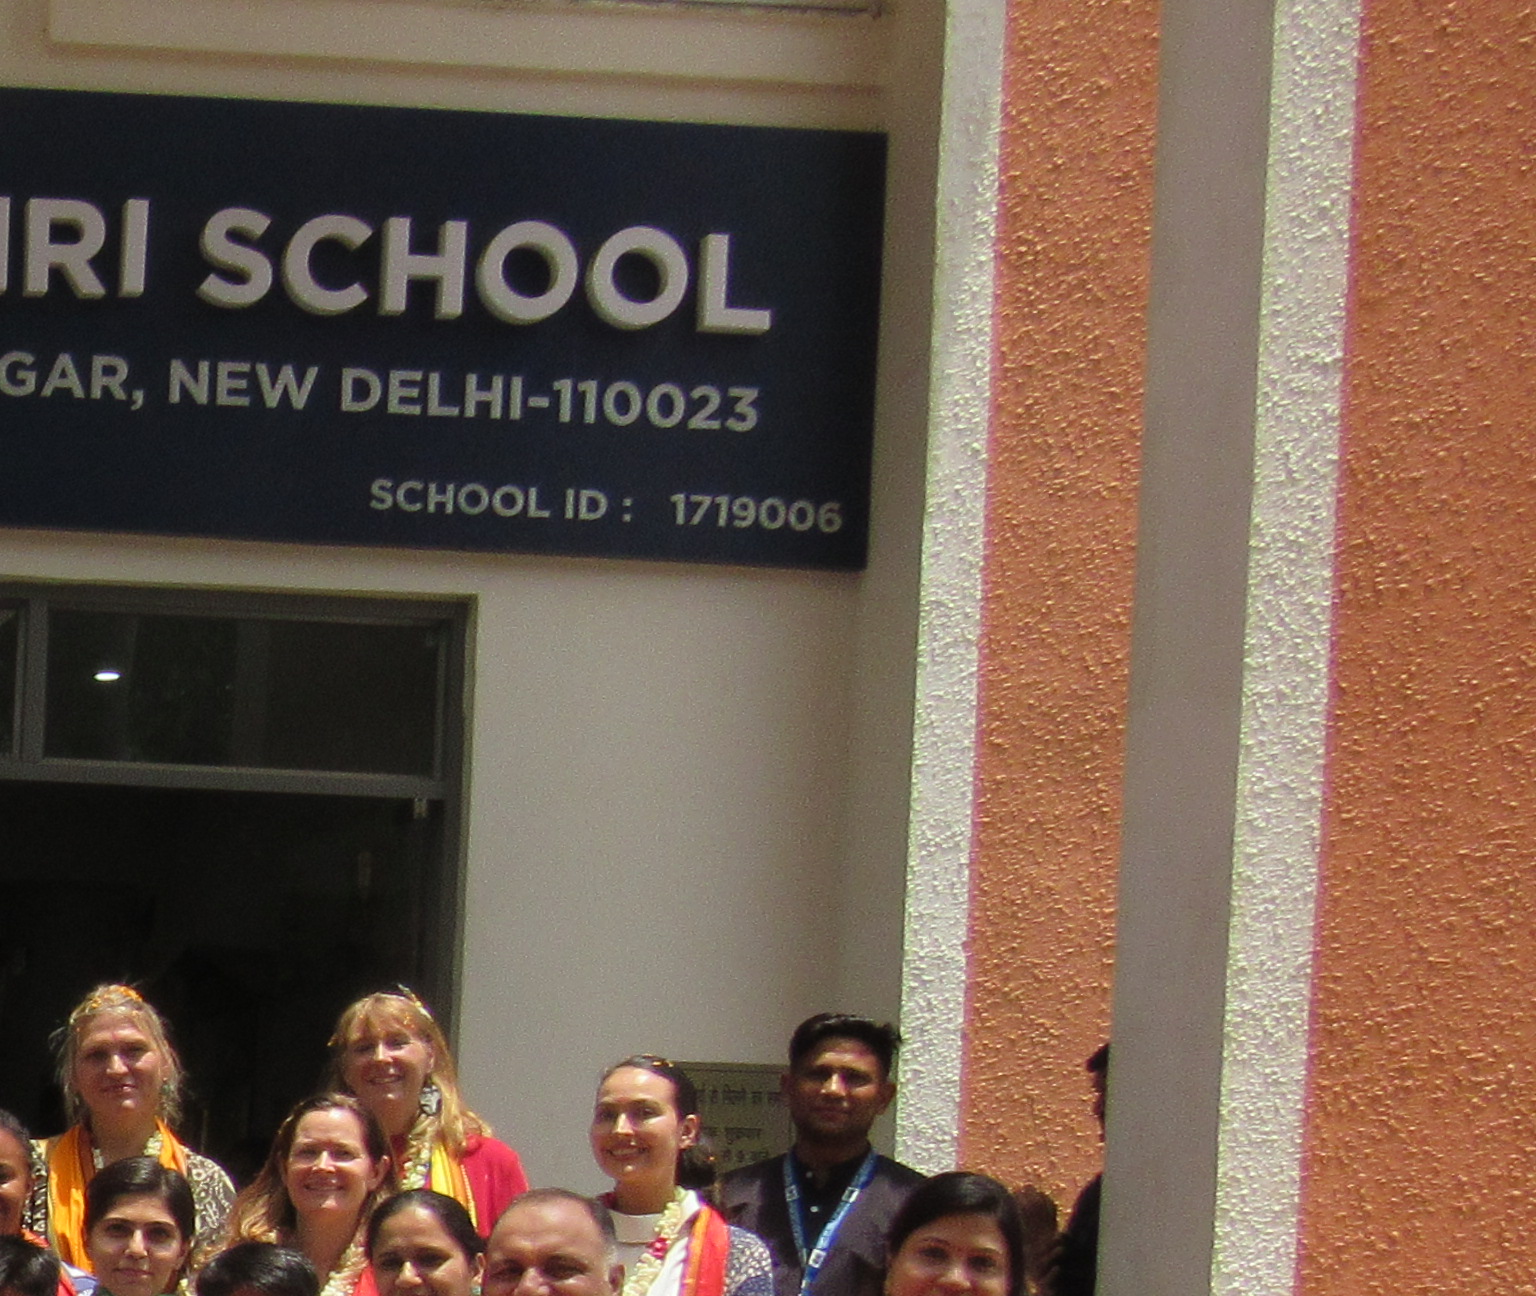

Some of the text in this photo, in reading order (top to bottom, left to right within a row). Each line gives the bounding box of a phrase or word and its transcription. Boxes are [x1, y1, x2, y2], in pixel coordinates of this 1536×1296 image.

[198, 206, 773, 334] SCHOOL
[168, 359, 320, 411] NEW
[339, 367, 761, 433] DELHI-110023
[368, 478, 553, 519] SCHOOL
[565, 487, 609, 521] ID
[669, 492, 843, 534] 1719006
